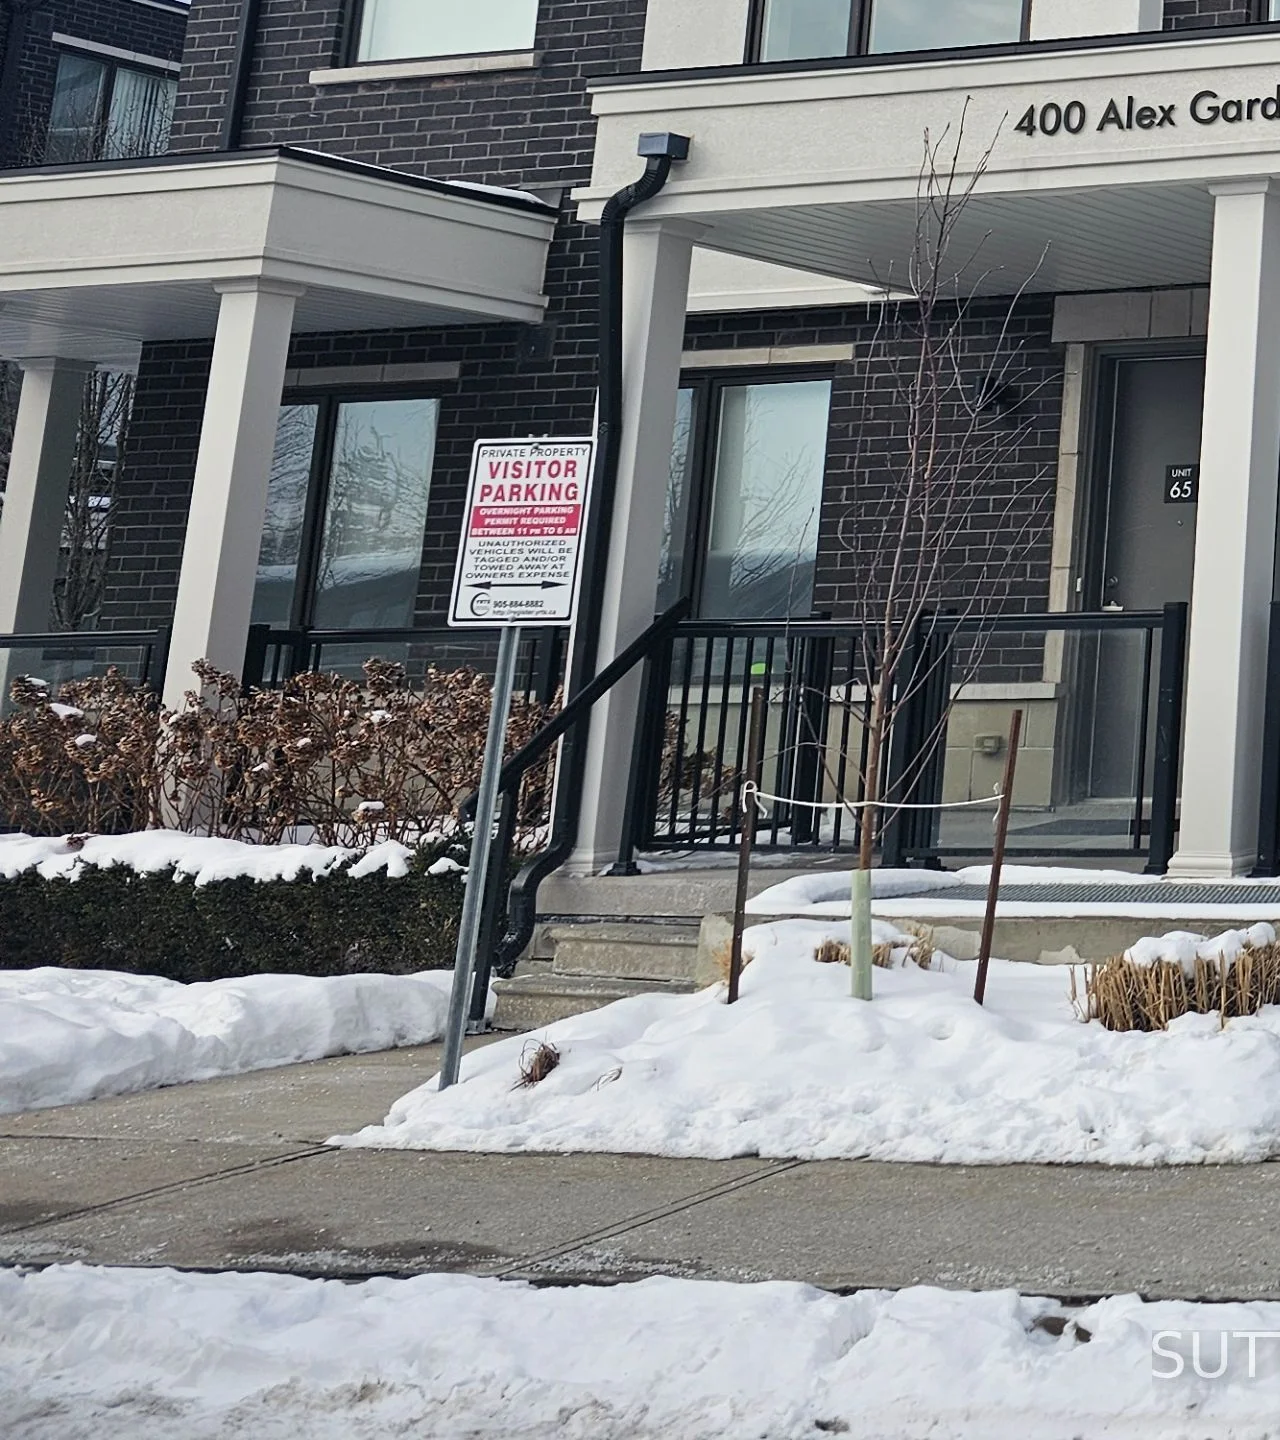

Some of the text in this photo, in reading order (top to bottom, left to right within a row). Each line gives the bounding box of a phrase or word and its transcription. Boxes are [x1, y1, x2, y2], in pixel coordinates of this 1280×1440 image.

[1014, 100, 1086, 137] 400
[1096, 95, 1176, 132] Alex
[481, 447, 588, 458] PRIVATE PROPERTY
[489, 460, 577, 479] VISITOR
[1171, 468, 1192, 477] UNIT
[480, 483, 578, 502] PARKING
[1169, 481, 1192, 498] 65
[480, 506, 574, 516] OVERNIGHT PARKING
[484, 517, 566, 526] PERMIT REQUIRED
[471, 527, 514, 536] BETWEEN
[517, 527, 527, 535] 11
[543, 527, 555, 535] TO
[469, 547, 524, 555] VEHICLES
[523, 555, 567, 563] AND/OR
[517, 563, 549, 571] AWAY
[465, 571, 514, 579] OWNERS
